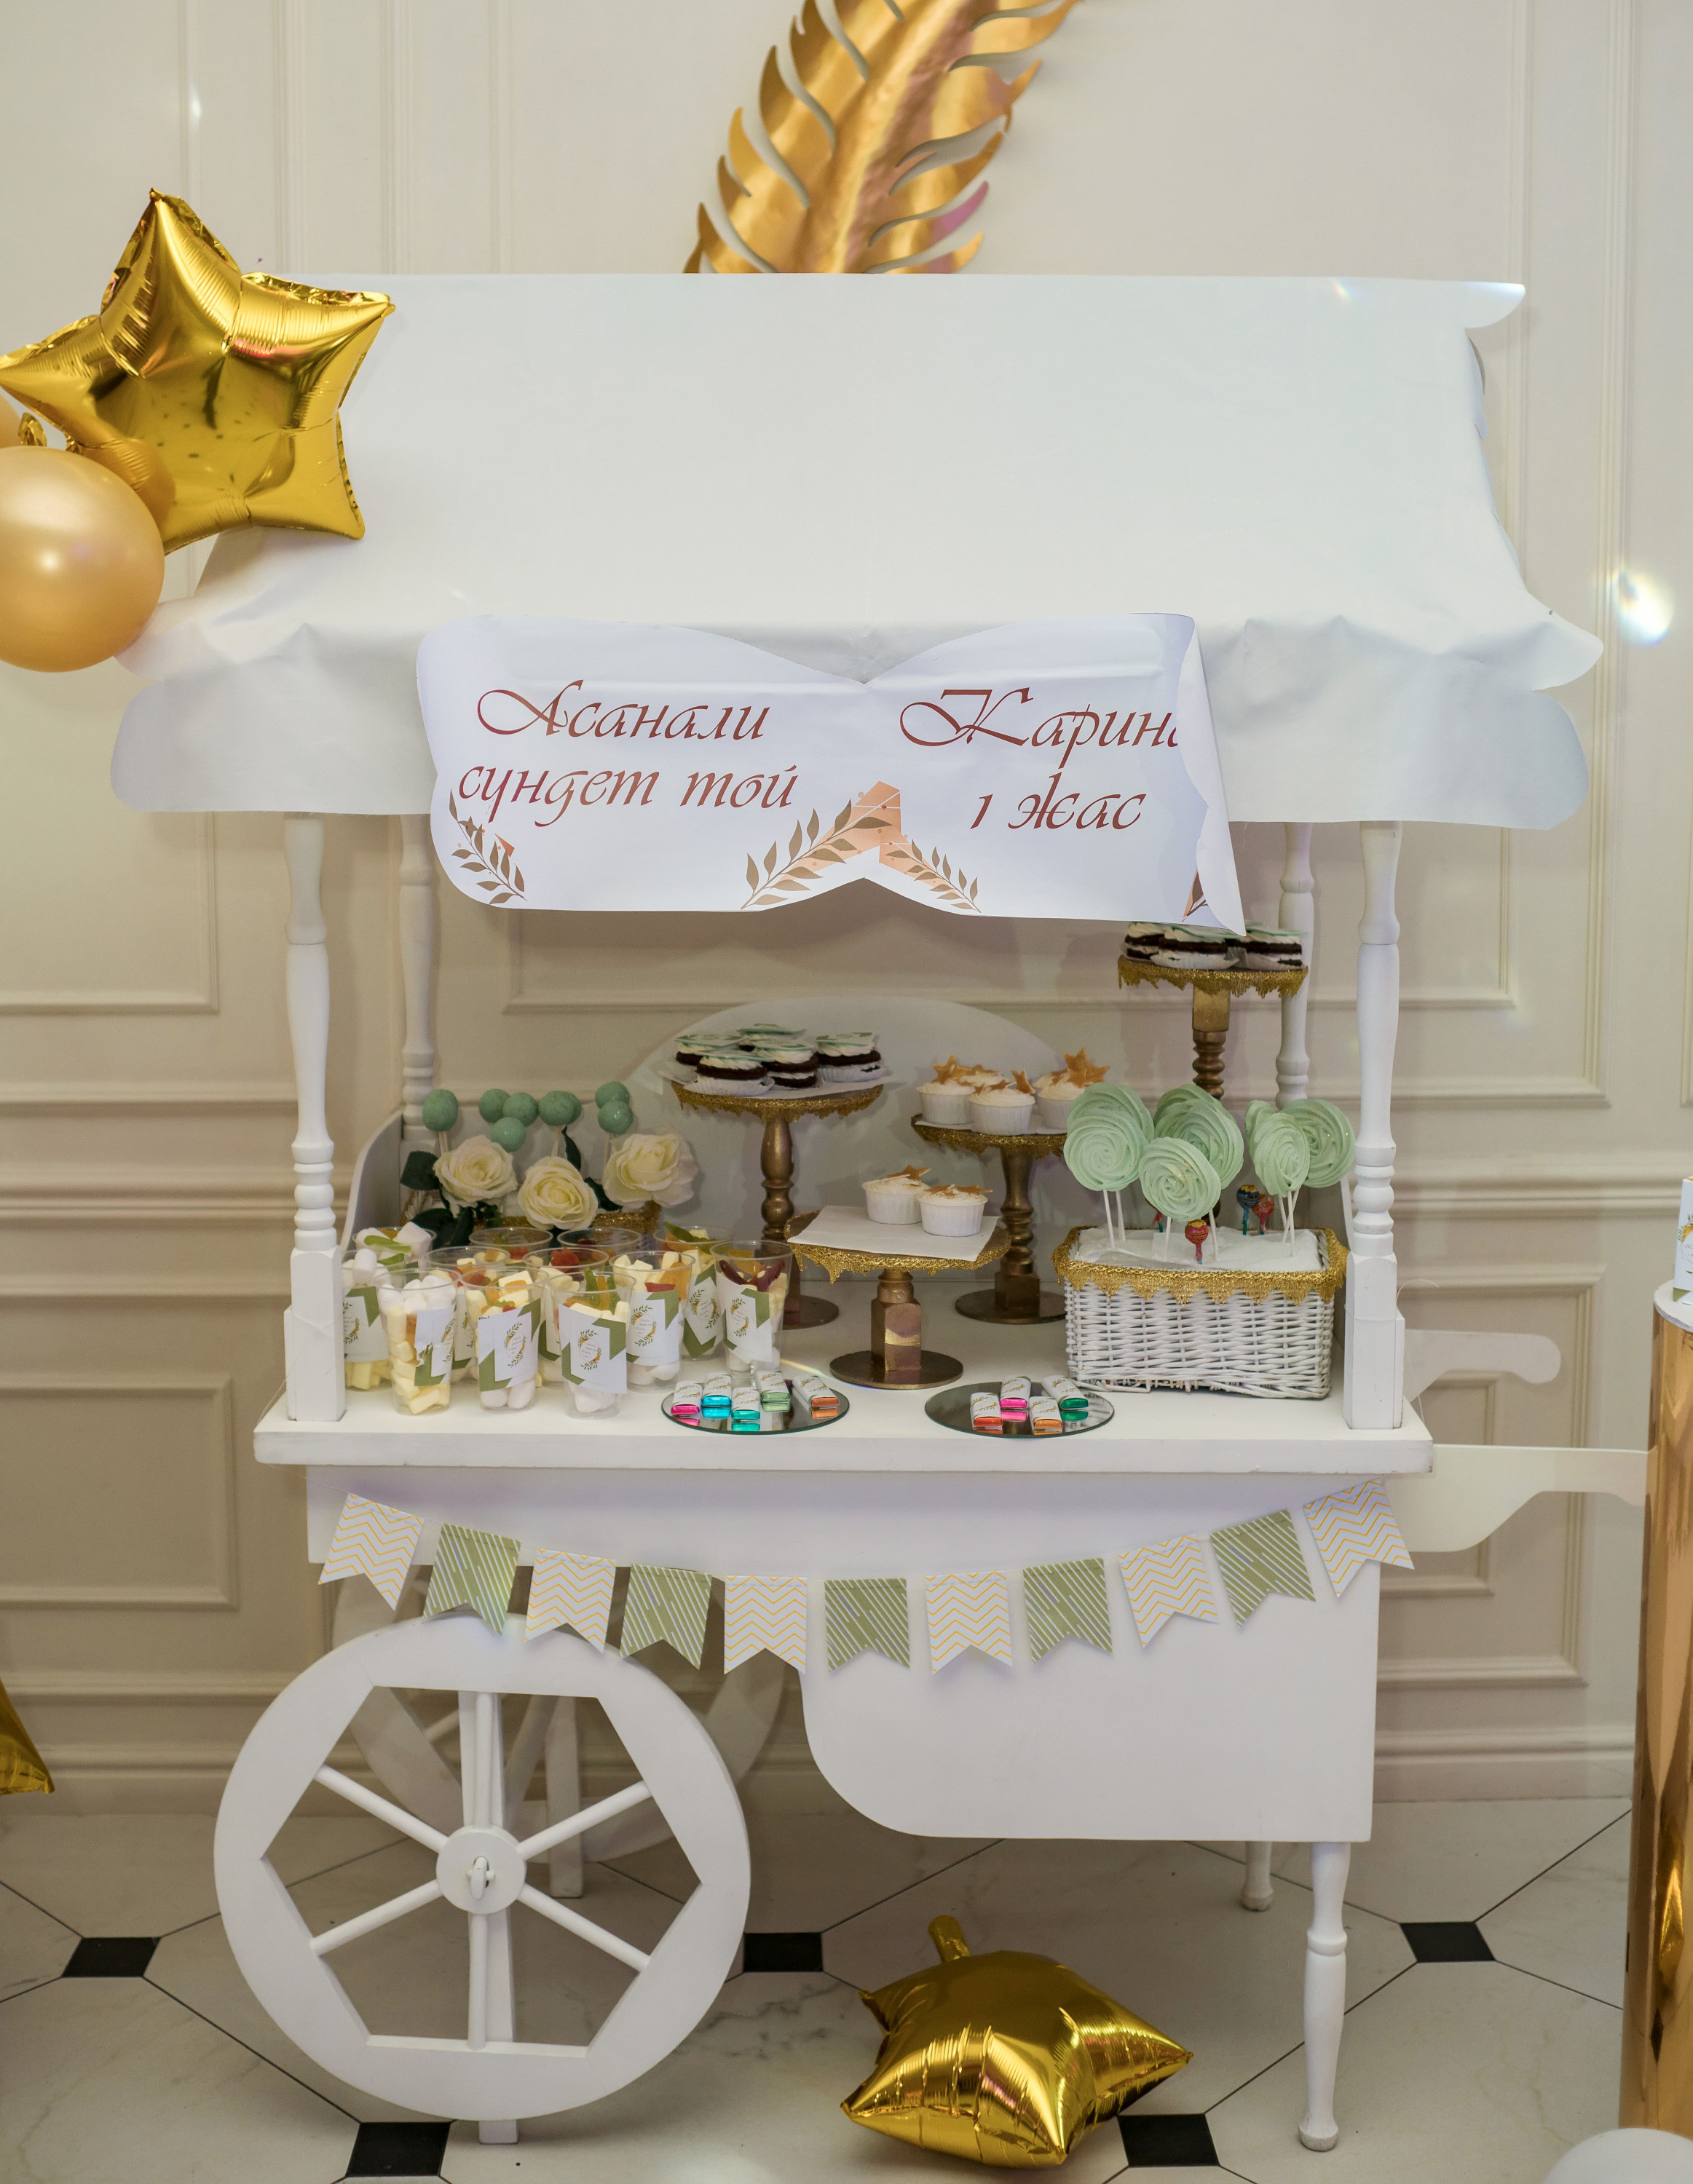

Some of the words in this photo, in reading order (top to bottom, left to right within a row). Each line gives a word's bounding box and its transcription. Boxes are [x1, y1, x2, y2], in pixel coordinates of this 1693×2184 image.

[478, 679, 770, 740] Асанали
[459, 766, 660, 828] сундет
[679, 764, 799, 809] той
[970, 794, 993, 829] 1
[1008, 772, 1147, 829] жас
